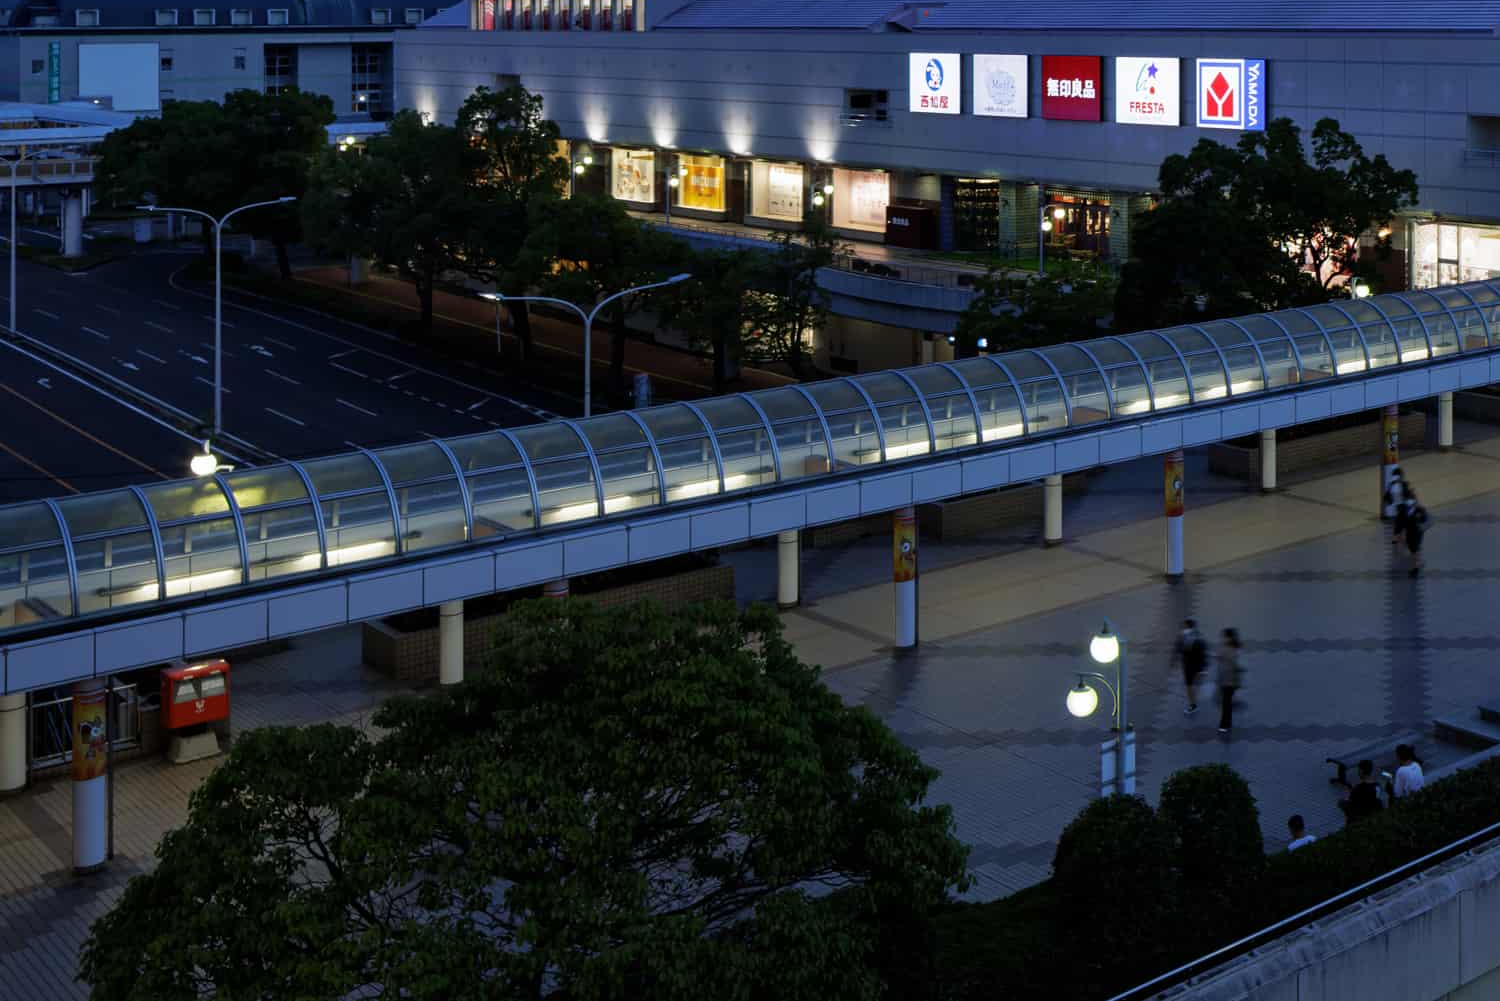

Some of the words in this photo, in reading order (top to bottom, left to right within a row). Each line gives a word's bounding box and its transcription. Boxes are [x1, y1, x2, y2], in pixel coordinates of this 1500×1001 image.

[1046, 78, 1096, 100] 無印良品
[1248, 63, 1260, 127] YAMADA
[1130, 101, 1165, 114] FRESTA
